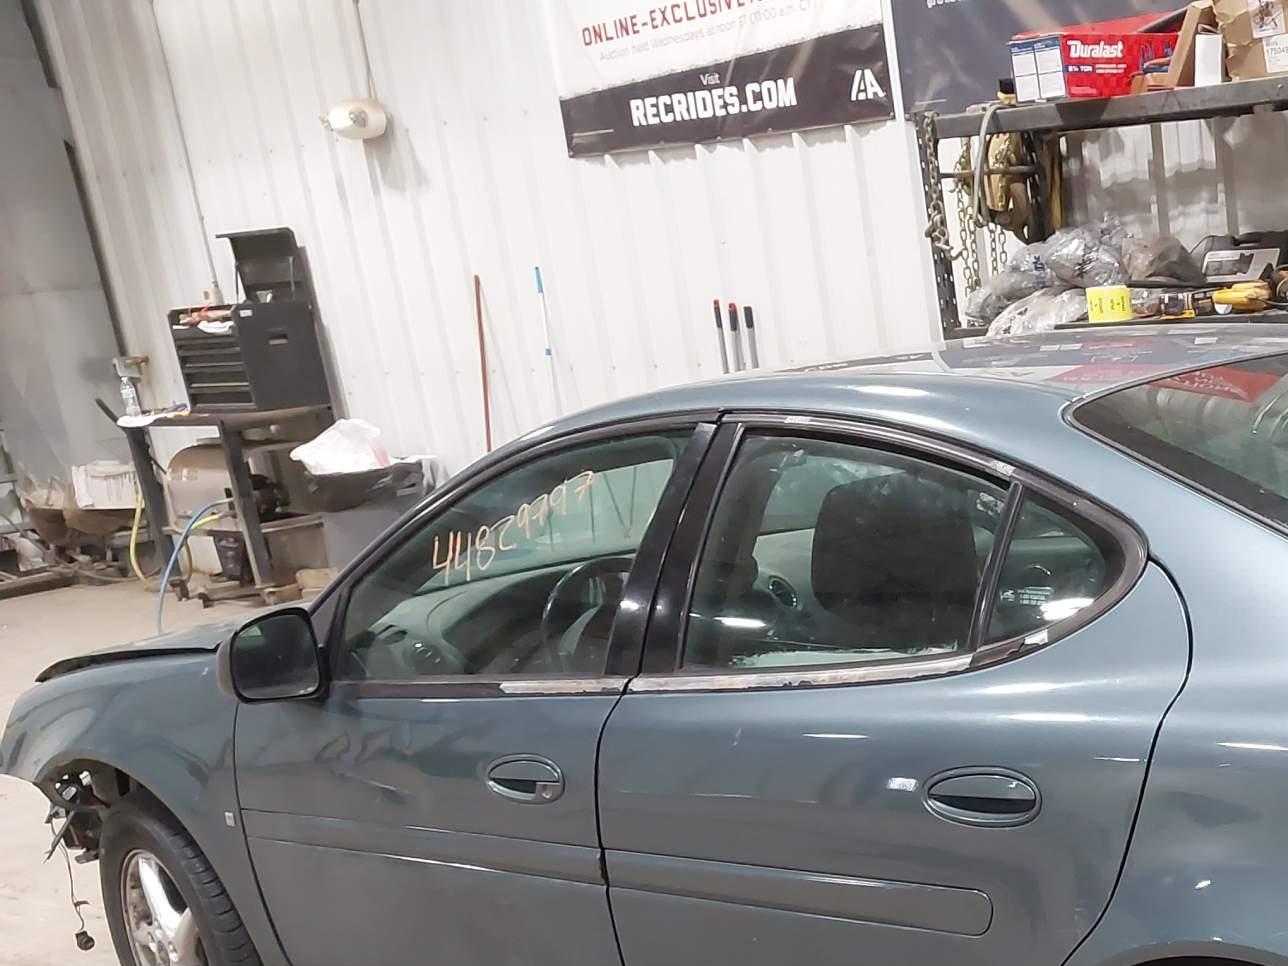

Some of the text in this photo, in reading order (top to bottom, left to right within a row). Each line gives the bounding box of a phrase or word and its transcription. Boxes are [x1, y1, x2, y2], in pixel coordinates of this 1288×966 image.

[1067, 39, 1124, 59] Duralast
[699, 72, 721, 87] Visit
[629, 77, 798, 127] RECRIDES.COM
